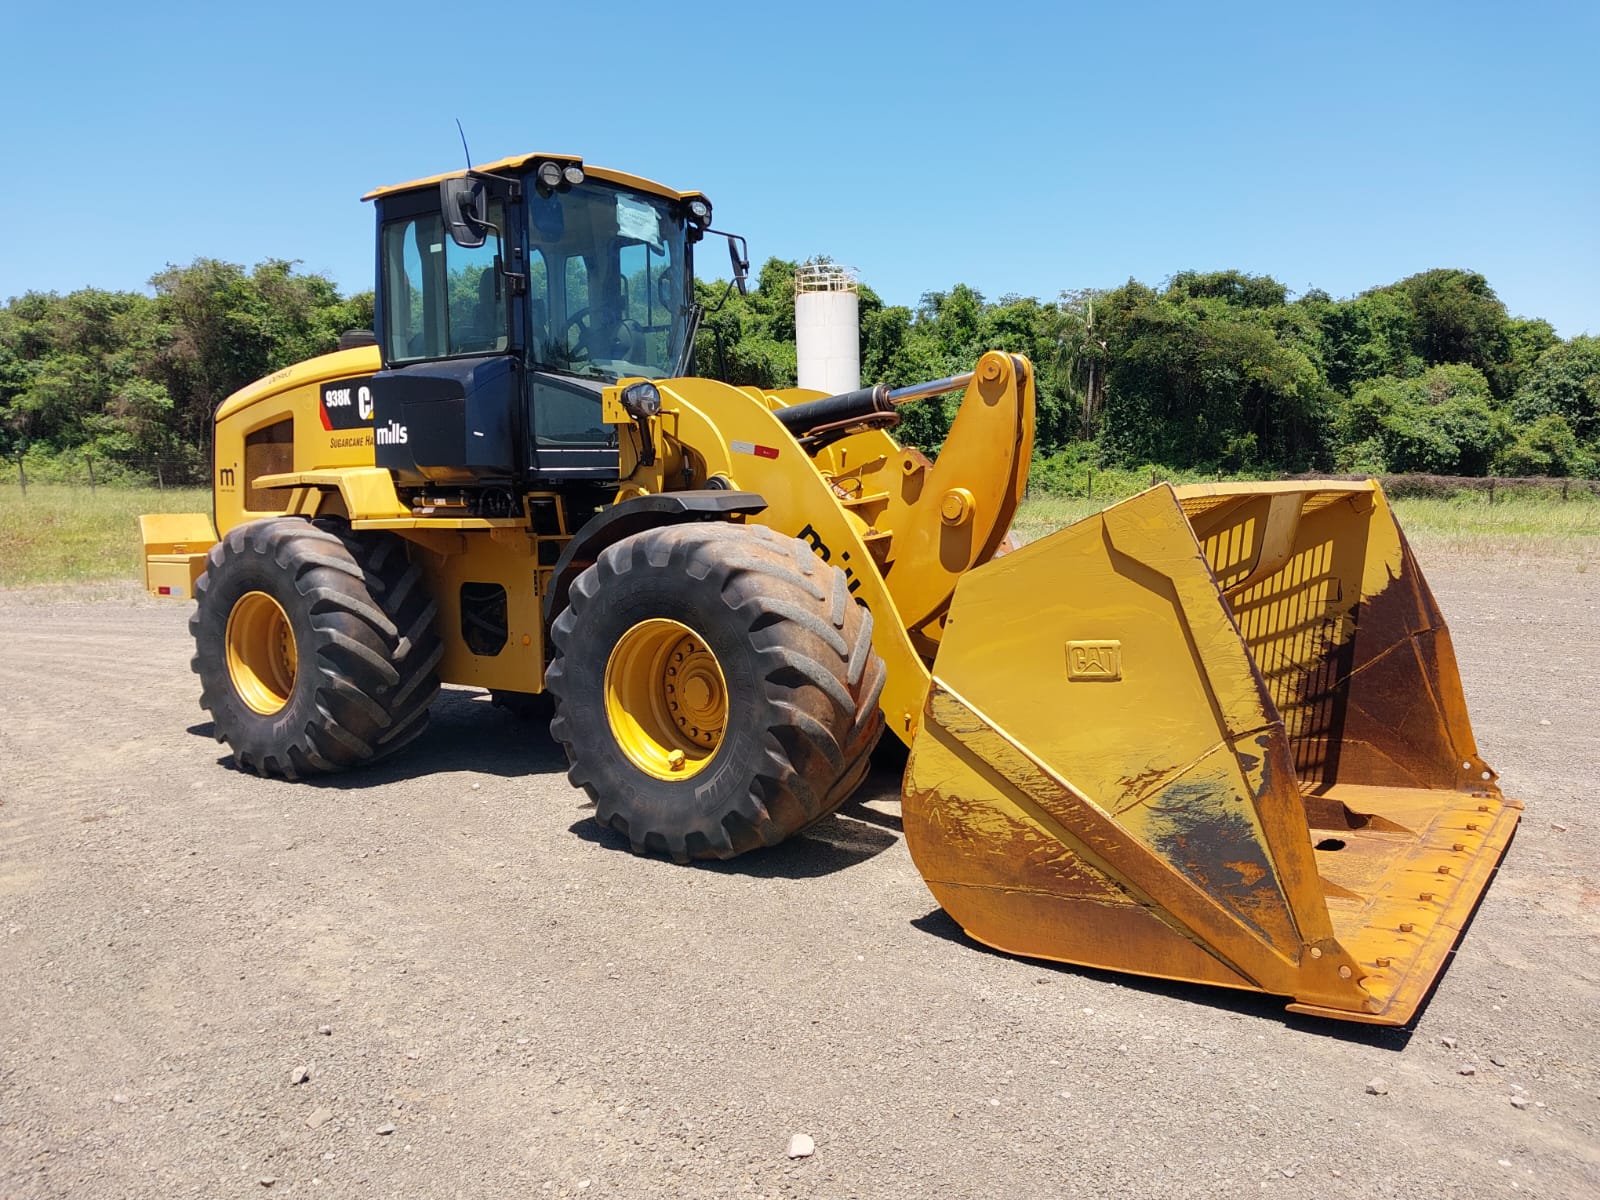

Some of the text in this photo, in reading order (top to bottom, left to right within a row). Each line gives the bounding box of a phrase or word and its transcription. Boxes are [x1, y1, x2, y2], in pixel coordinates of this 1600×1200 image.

[325, 388, 351, 407] 938K
[376, 419, 408, 445] mills
[1071, 646, 1113, 673] CAT
